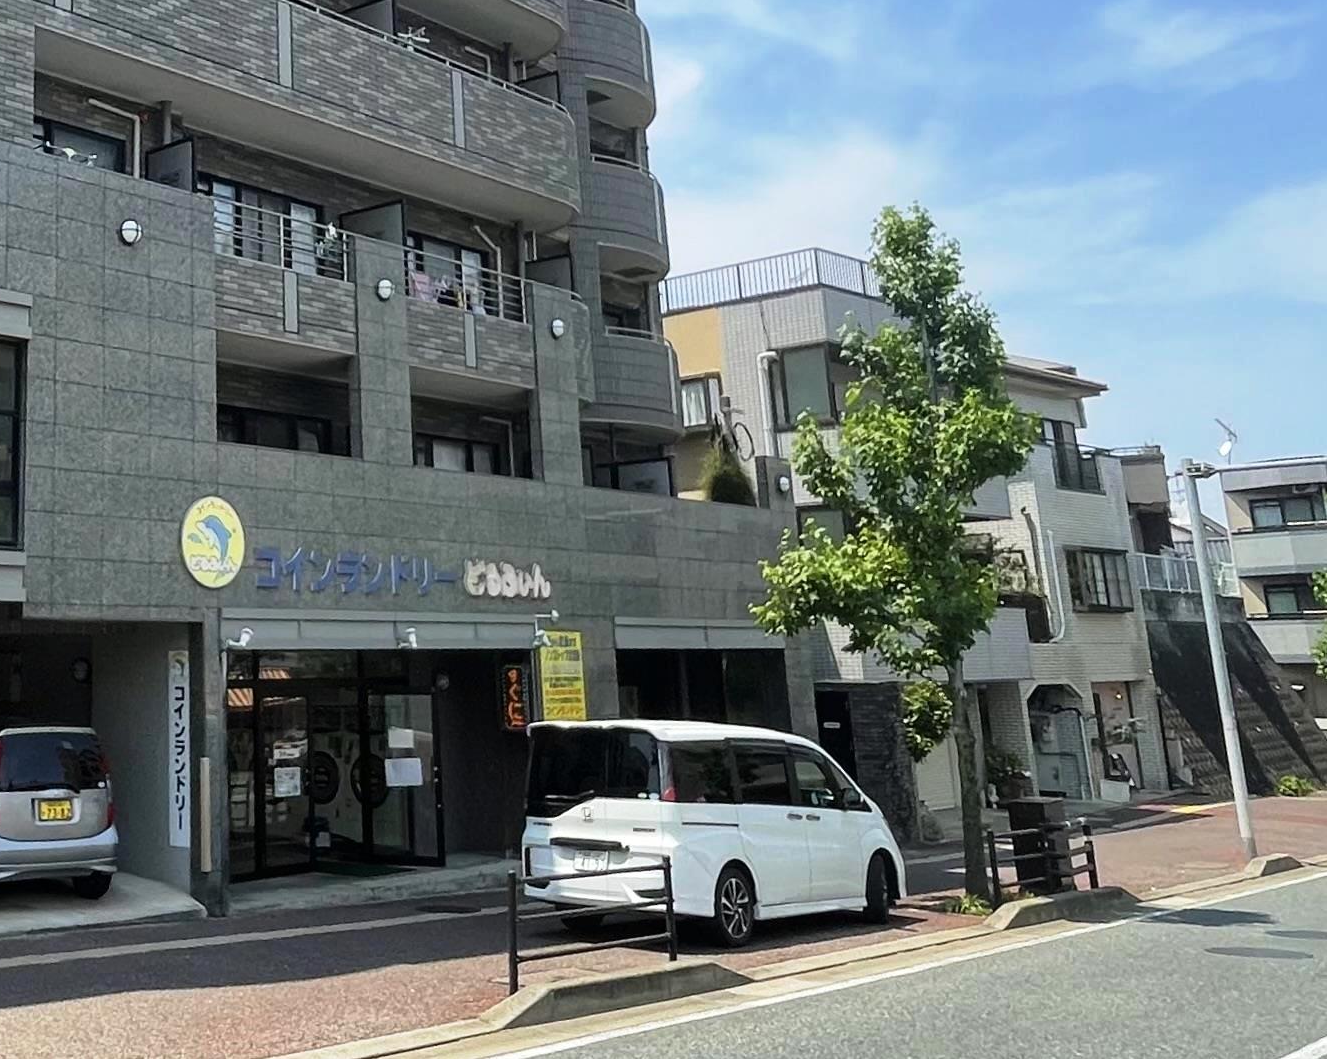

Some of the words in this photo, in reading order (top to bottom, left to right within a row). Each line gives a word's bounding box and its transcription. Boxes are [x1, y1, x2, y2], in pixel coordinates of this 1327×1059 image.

[255, 547, 458, 596] コインランドリー
[174, 686, 186, 830] コインランドリー
